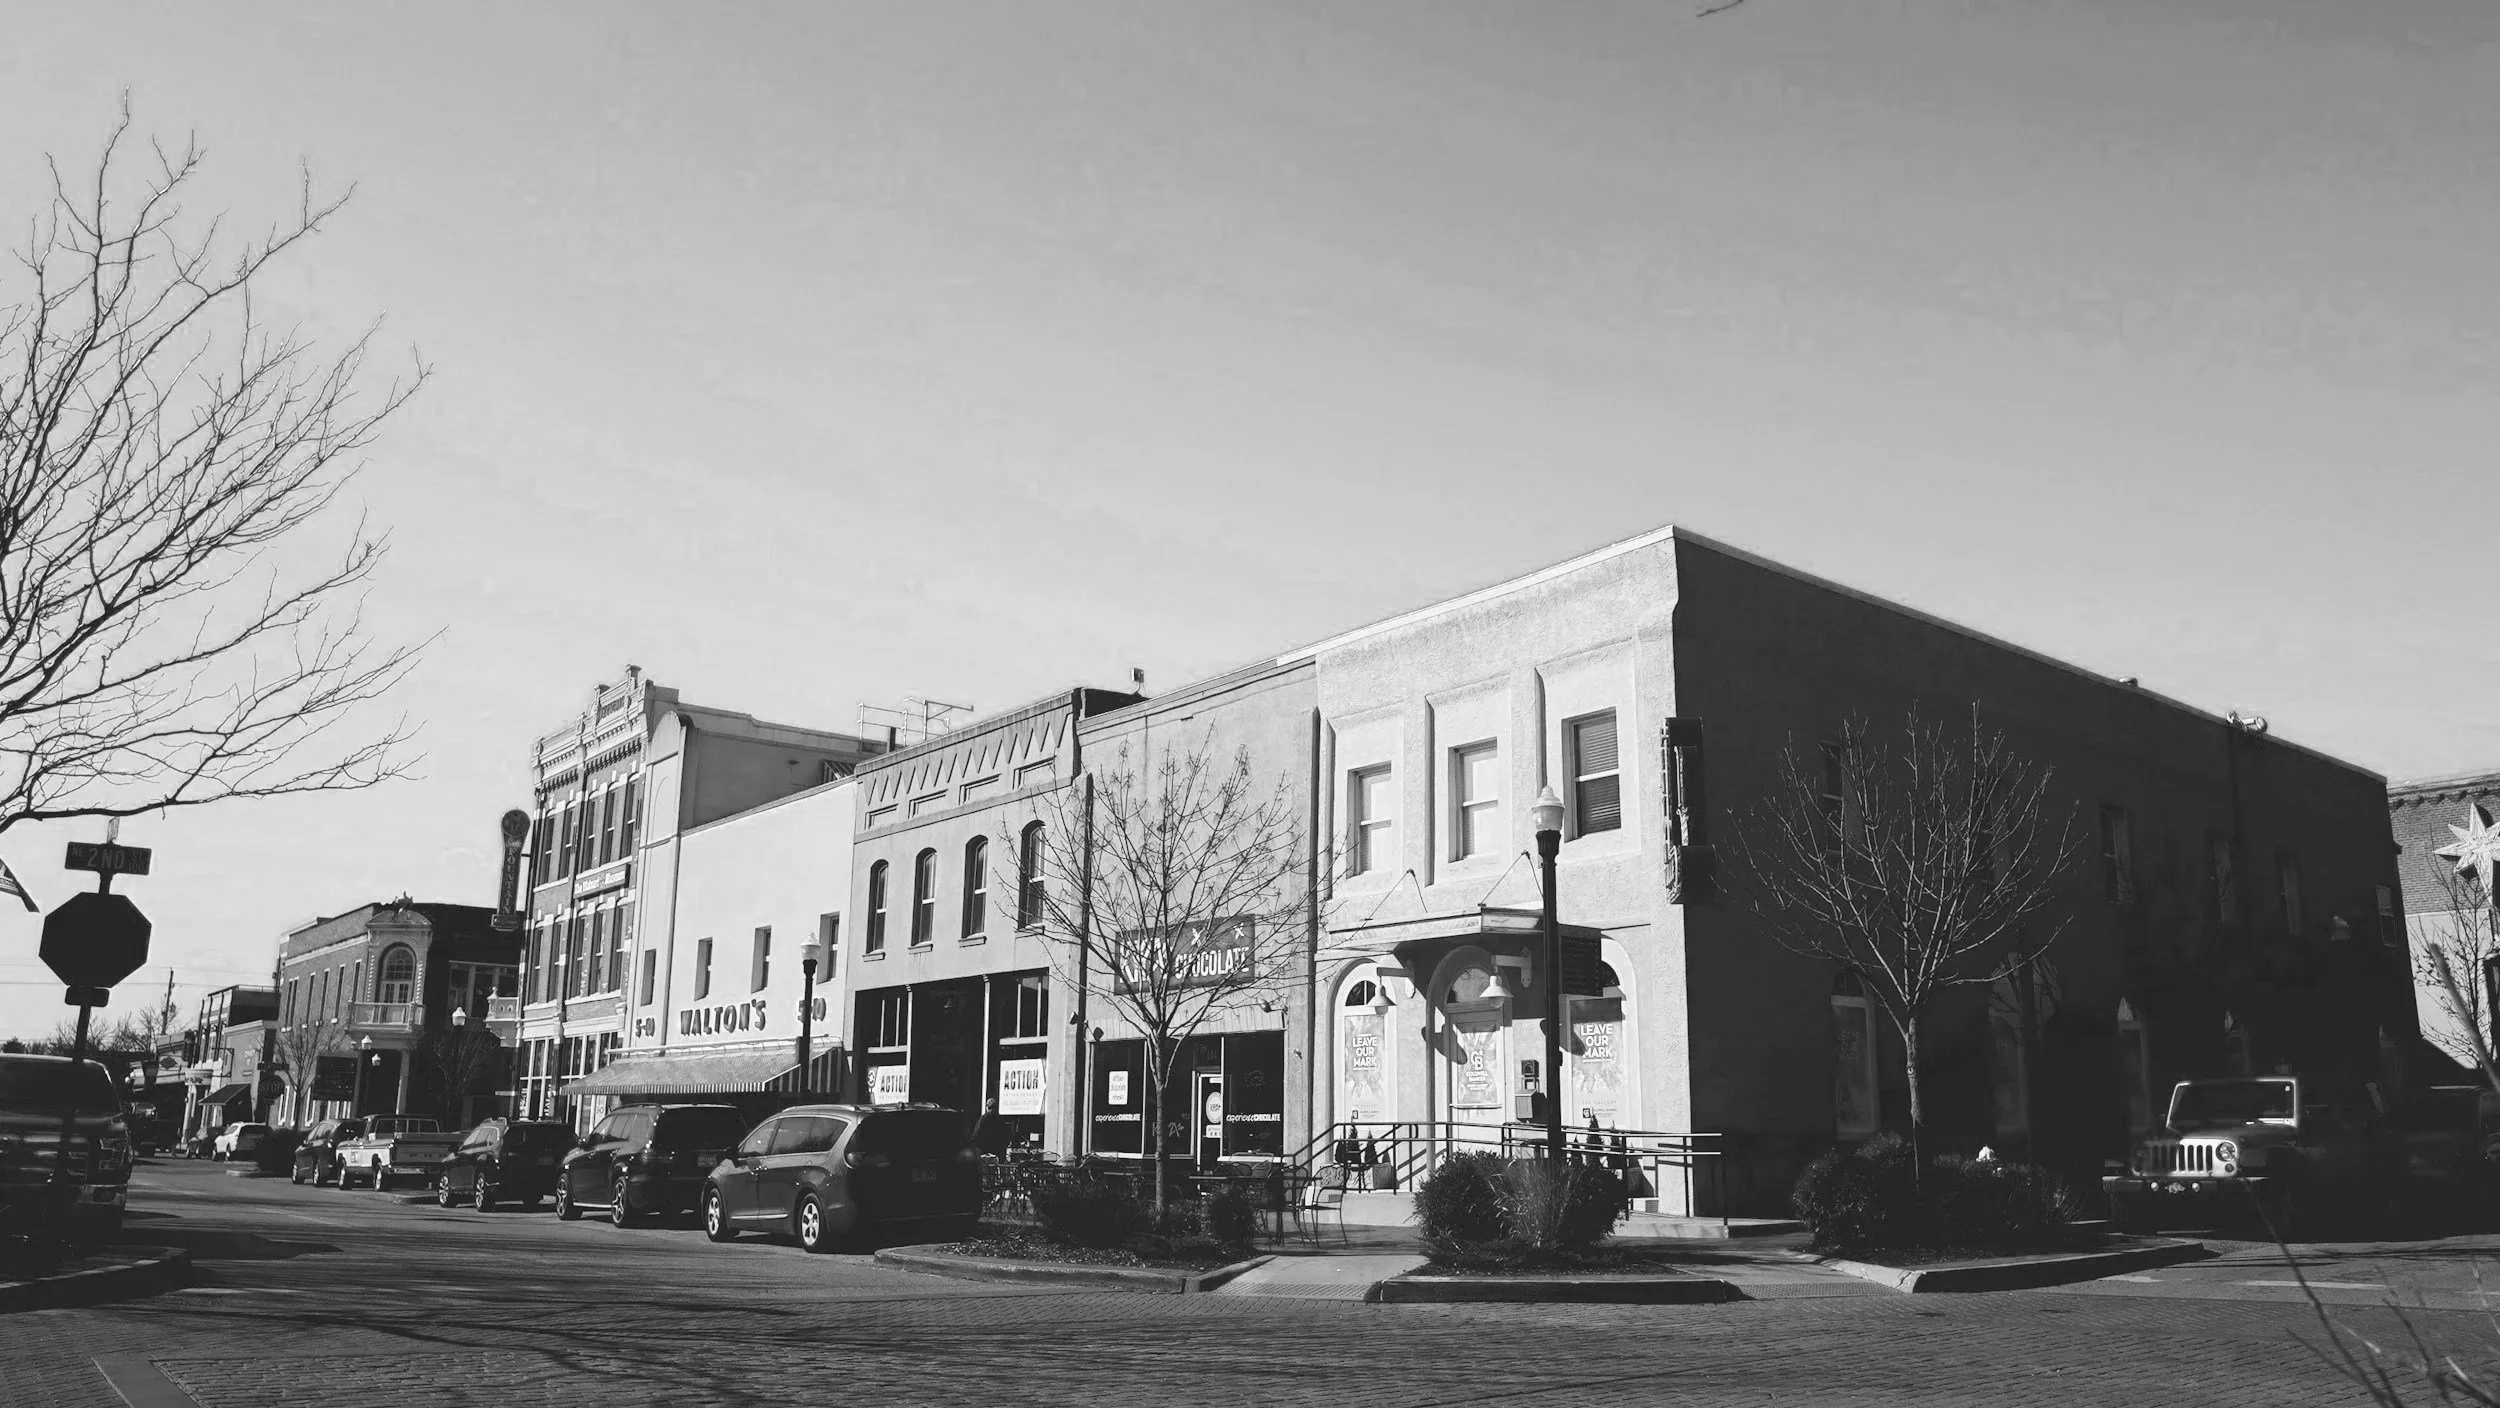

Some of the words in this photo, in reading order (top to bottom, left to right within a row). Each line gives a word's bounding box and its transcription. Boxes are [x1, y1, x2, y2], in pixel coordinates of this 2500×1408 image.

[72, 845, 86, 857] NE
[87, 847, 125, 870] 2ND
[680, 998, 766, 1036] WALTON'S
[1580, 1023, 1613, 1036] LEAVE
[1352, 1036, 1378, 1047] LEAVE
[1585, 1035, 1609, 1047] OUR
[1355, 1047, 1375, 1057] OUR
[1582, 1046, 1614, 1059] MARK
[1352, 1056, 1378, 1067] MARK
[1003, 1070, 1039, 1090] ACTION
